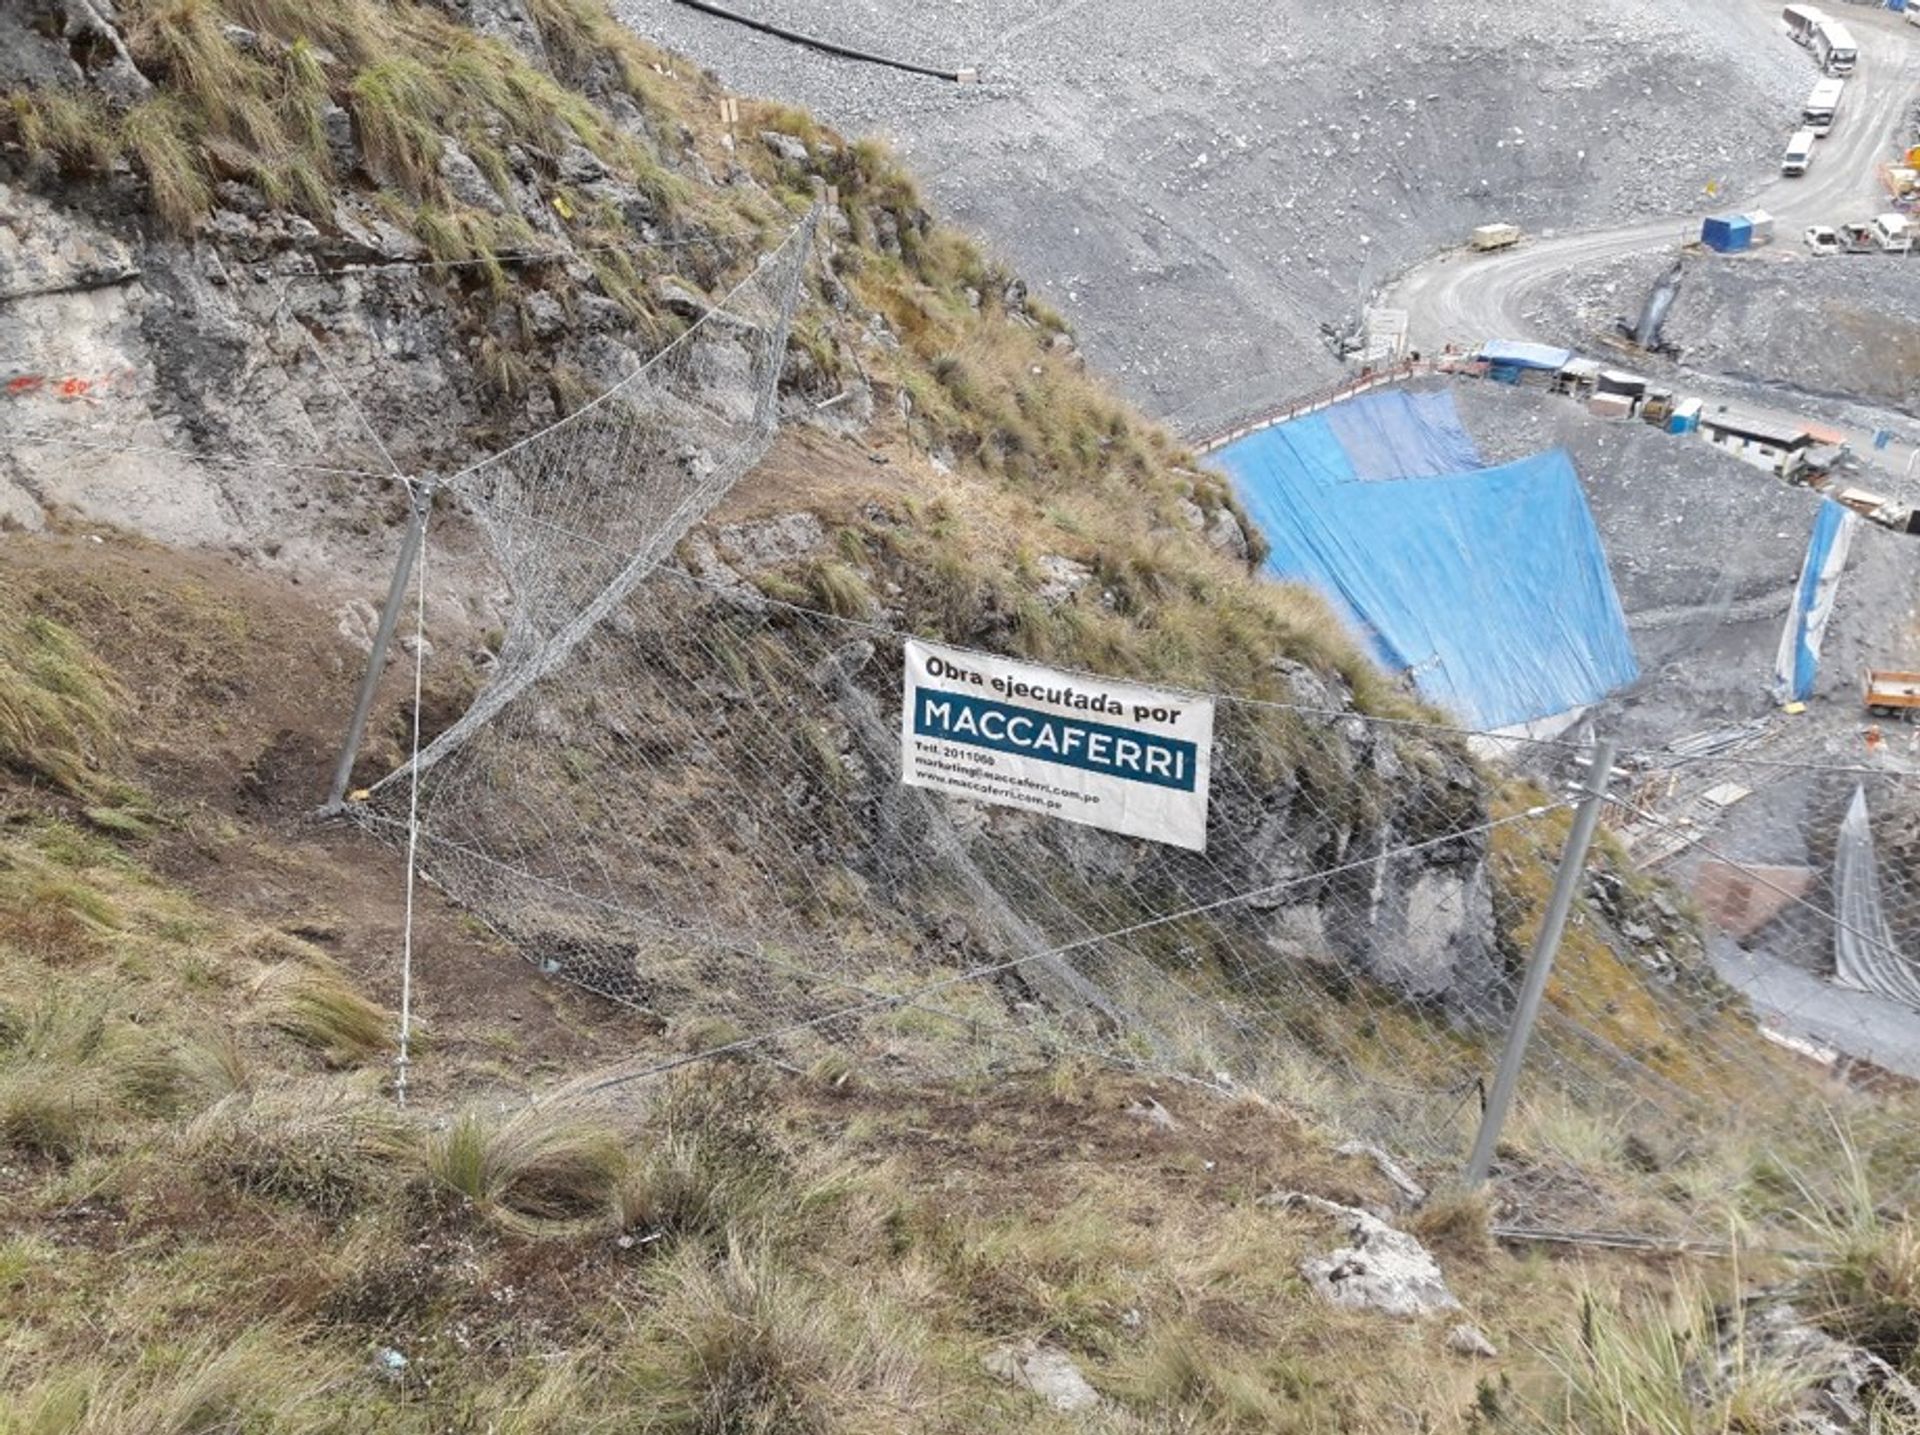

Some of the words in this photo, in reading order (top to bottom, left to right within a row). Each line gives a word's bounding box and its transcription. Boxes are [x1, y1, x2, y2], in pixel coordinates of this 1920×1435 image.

[925, 656, 984, 686] Obra
[991, 675, 1123, 717] ejecutada
[1133, 705, 1182, 725] por
[924, 699, 1184, 779] MACCAFERRI
